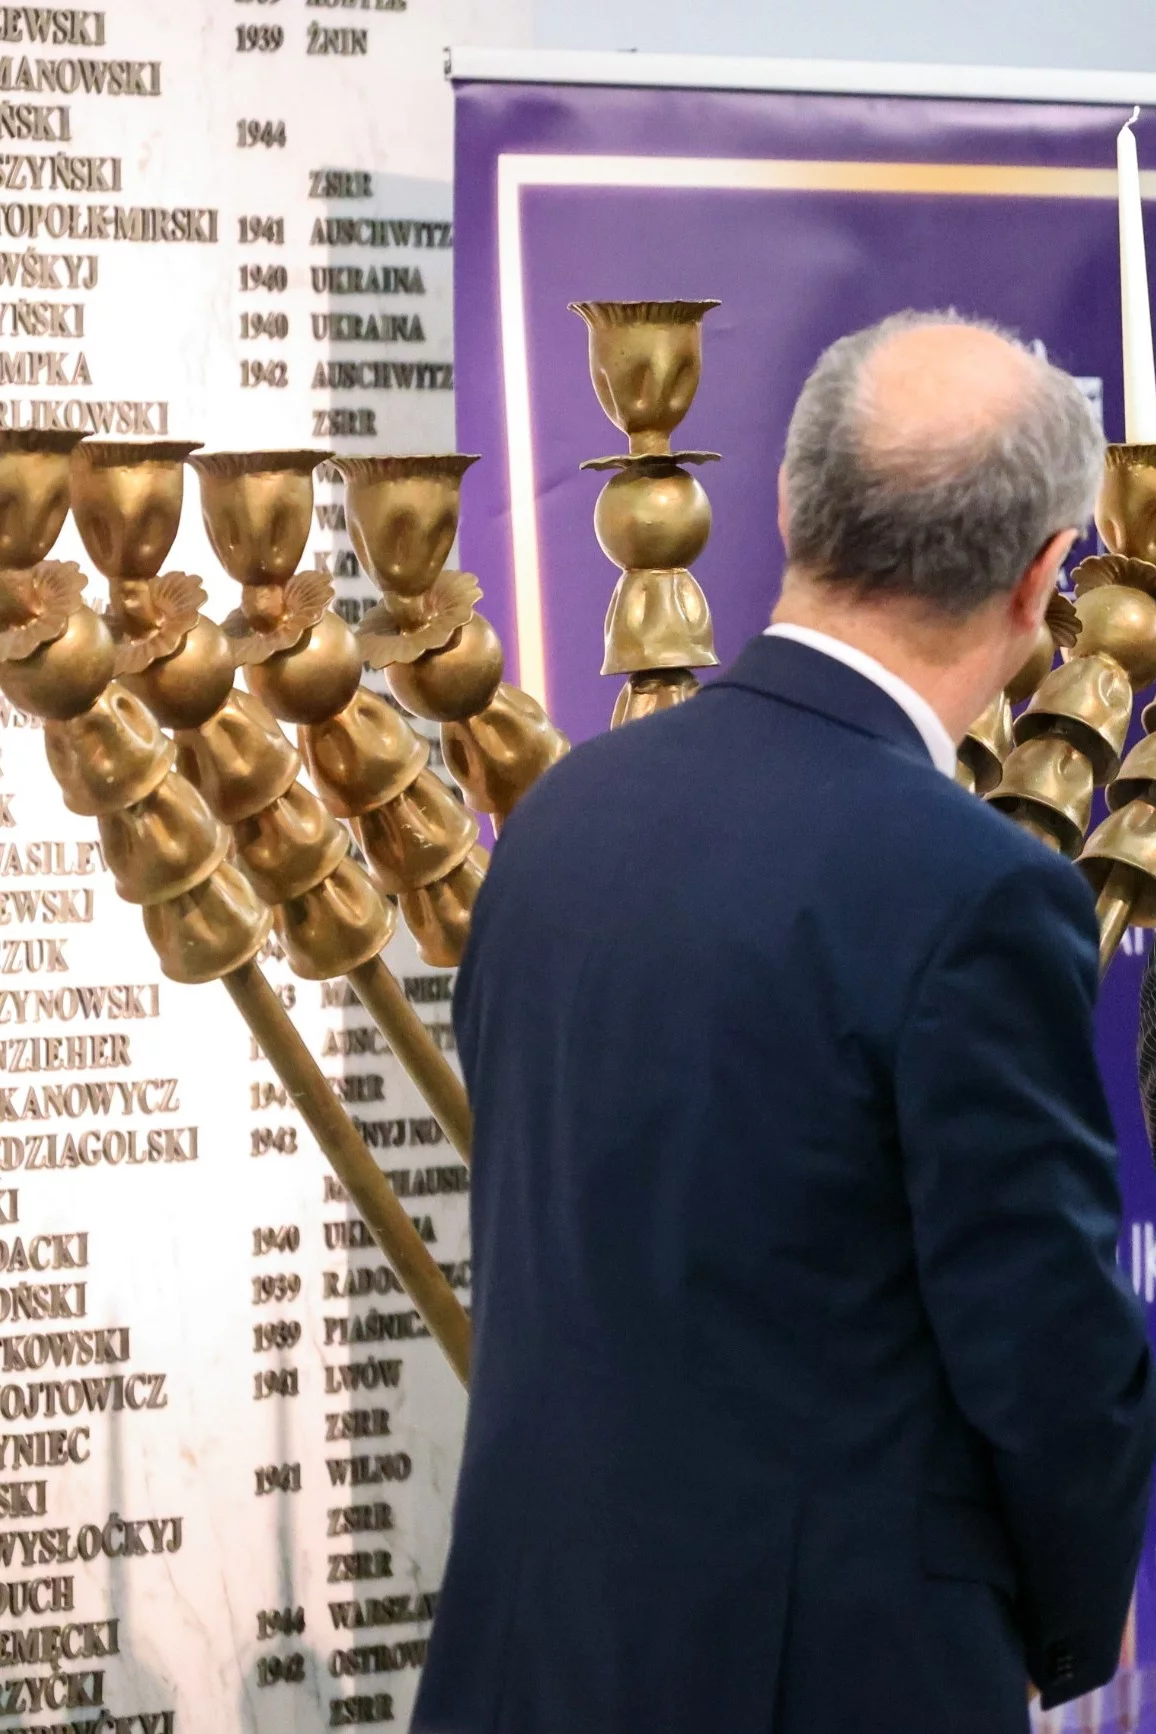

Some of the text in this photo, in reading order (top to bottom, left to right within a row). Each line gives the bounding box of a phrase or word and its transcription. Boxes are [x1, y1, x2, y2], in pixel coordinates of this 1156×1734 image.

[0, 6, 106, 46] EWSKI
[236, 24, 284, 53] 1939
[237, 118, 287, 148] 1944
[0, 151, 373, 198] ZYŃSKI ZSRR
[237, 214, 285, 245] 1941
[309, 216, 453, 249] AUSCHWITZ
[239, 264, 288, 293] 1940
[309, 265, 426, 295] UKRAINA
[239, 311, 289, 341] 1940
[309, 313, 426, 342] UKRAINA
[240, 359, 288, 388] 1942
[311, 360, 453, 391] AUSCHWITZ
[312, 407, 377, 437] ZSRR
[0, 840, 108, 877] ASILE
[250, 1082, 300, 1110] 194
[328, 1074, 385, 1102] SRR
[0, 1126, 199, 1172] DZIAGOLSKI
[252, 1224, 301, 1257] 1940
[252, 1272, 302, 1305] 1939
[0, 1307, 432, 1372] KOWSKI 1939 PIAŚNIC
[0, 1355, 402, 1421] OJTOWICZ 1941 LWÓW
[325, 1408, 391, 1442] ZSRR
[325, 1452, 412, 1488] WILNO
[326, 1502, 394, 1538] ZSRR
[326, 1550, 393, 1584] ZSRR
[0, 1670, 106, 1716] ZYCKI
[328, 1693, 395, 1728] ZSRR
